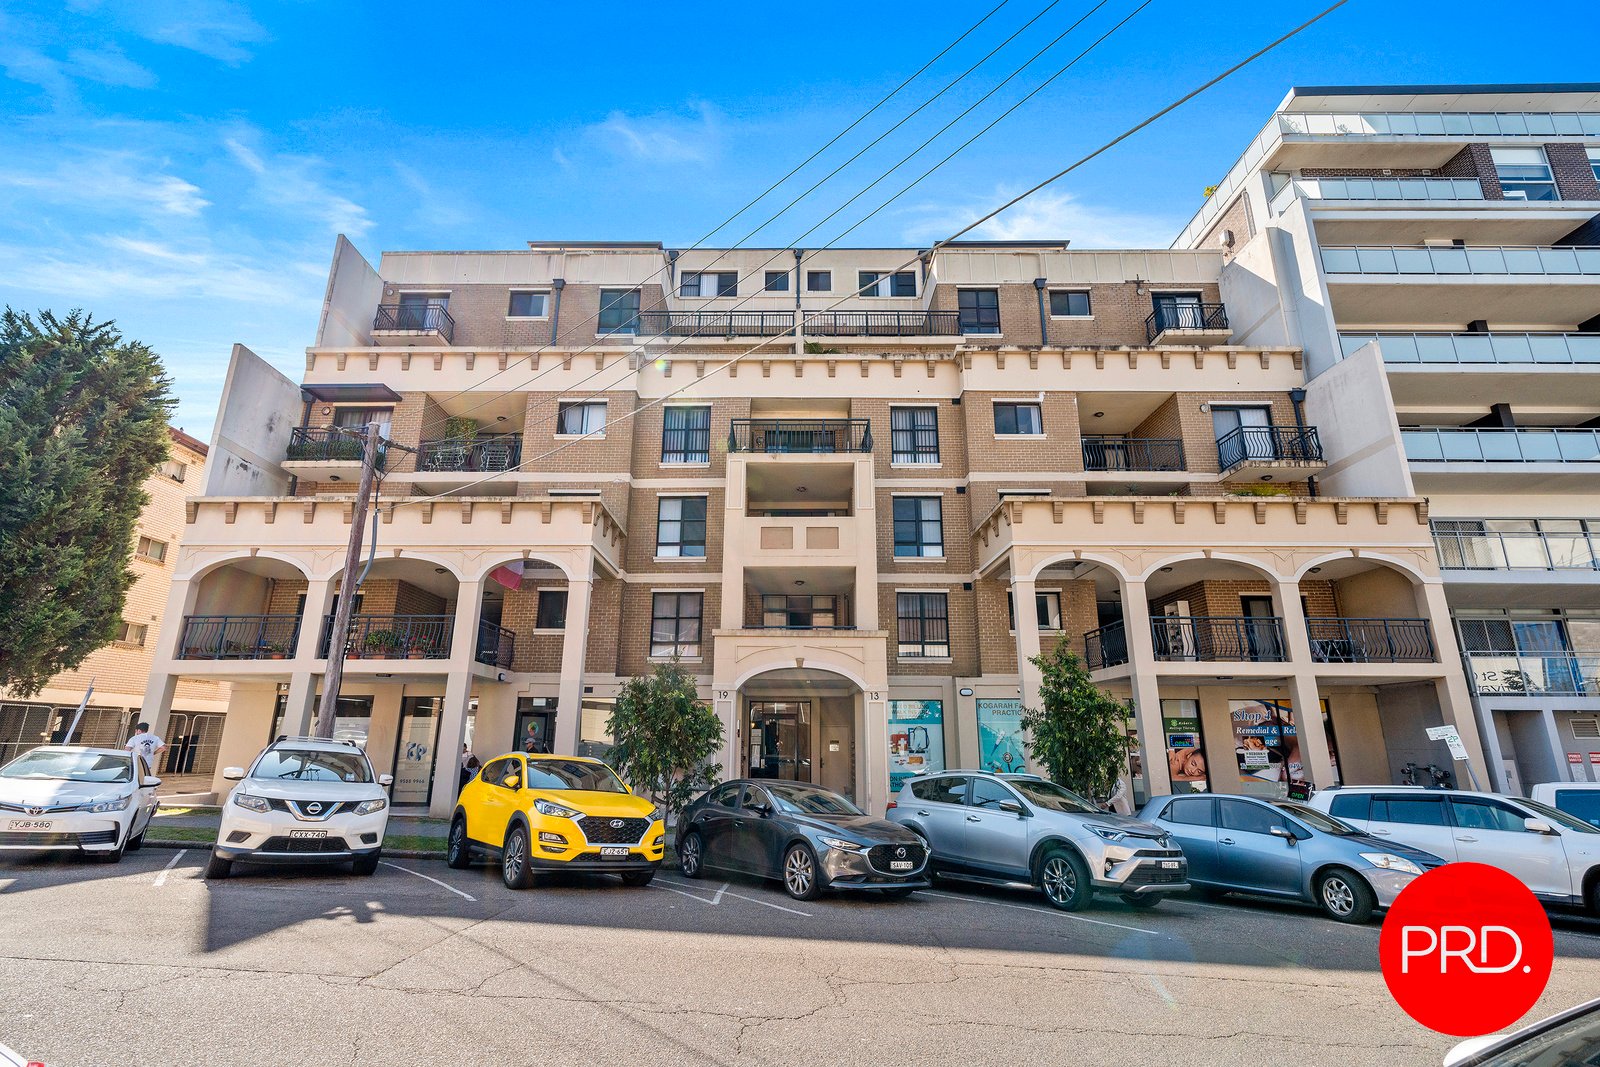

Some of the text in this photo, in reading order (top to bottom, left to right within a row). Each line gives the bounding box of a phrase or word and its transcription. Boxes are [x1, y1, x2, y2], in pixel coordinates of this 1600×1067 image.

[718, 691, 729, 700] 19
[869, 692, 880, 701] 13
[978, 702, 1013, 710] KOGARAH
[1233, 709, 1272, 725] Shop 4
[1236, 726, 1269, 734] Remedial
